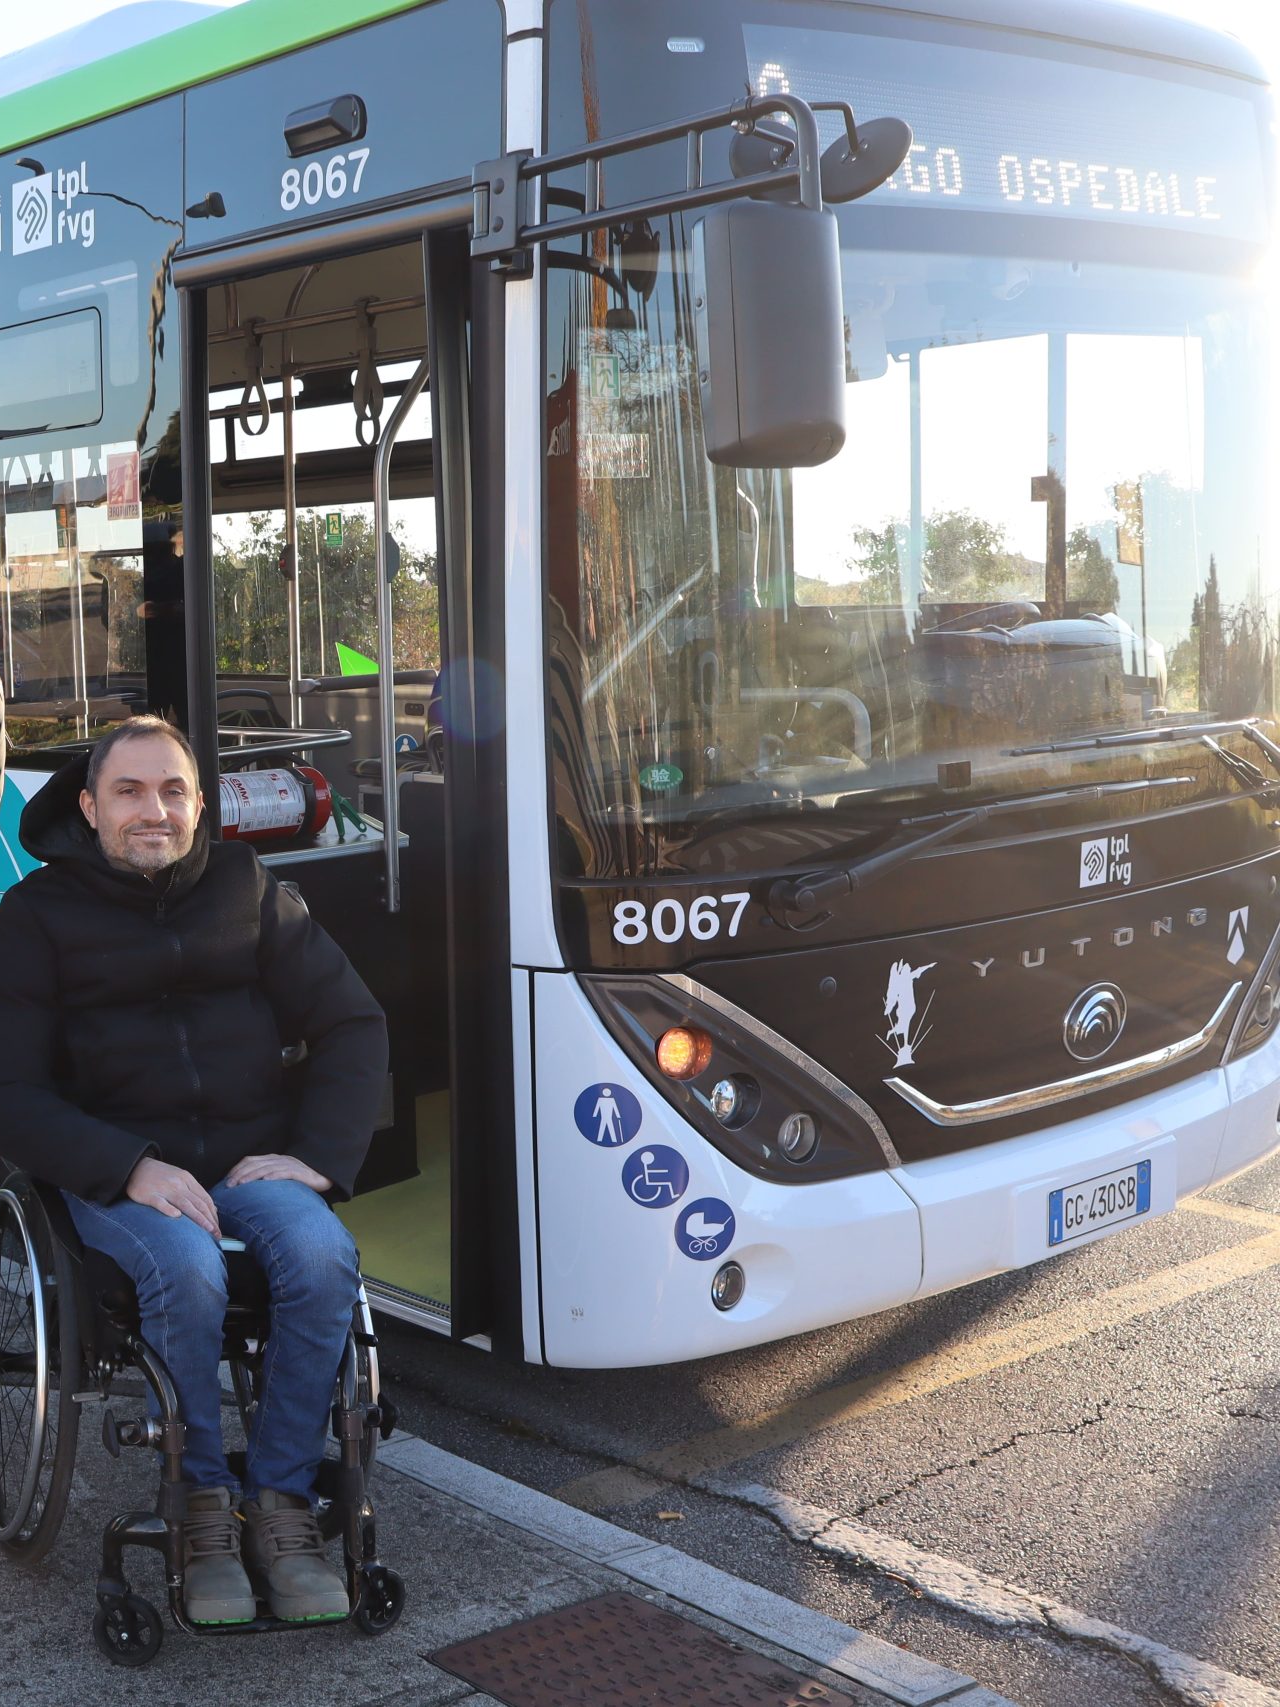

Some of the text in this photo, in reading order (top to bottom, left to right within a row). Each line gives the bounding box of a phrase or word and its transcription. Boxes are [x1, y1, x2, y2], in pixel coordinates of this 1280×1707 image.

[57, 161, 89, 209] tpl
[280, 147, 372, 211] 8067
[886, 144, 1222, 220] GO OSPEDALE
[57, 208, 95, 248] fvg
[1110, 833, 1130, 862] tpl
[1109, 861, 1132, 886] fvg
[613, 892, 751, 946] 8067
[970, 906, 1209, 978] YUTONG
